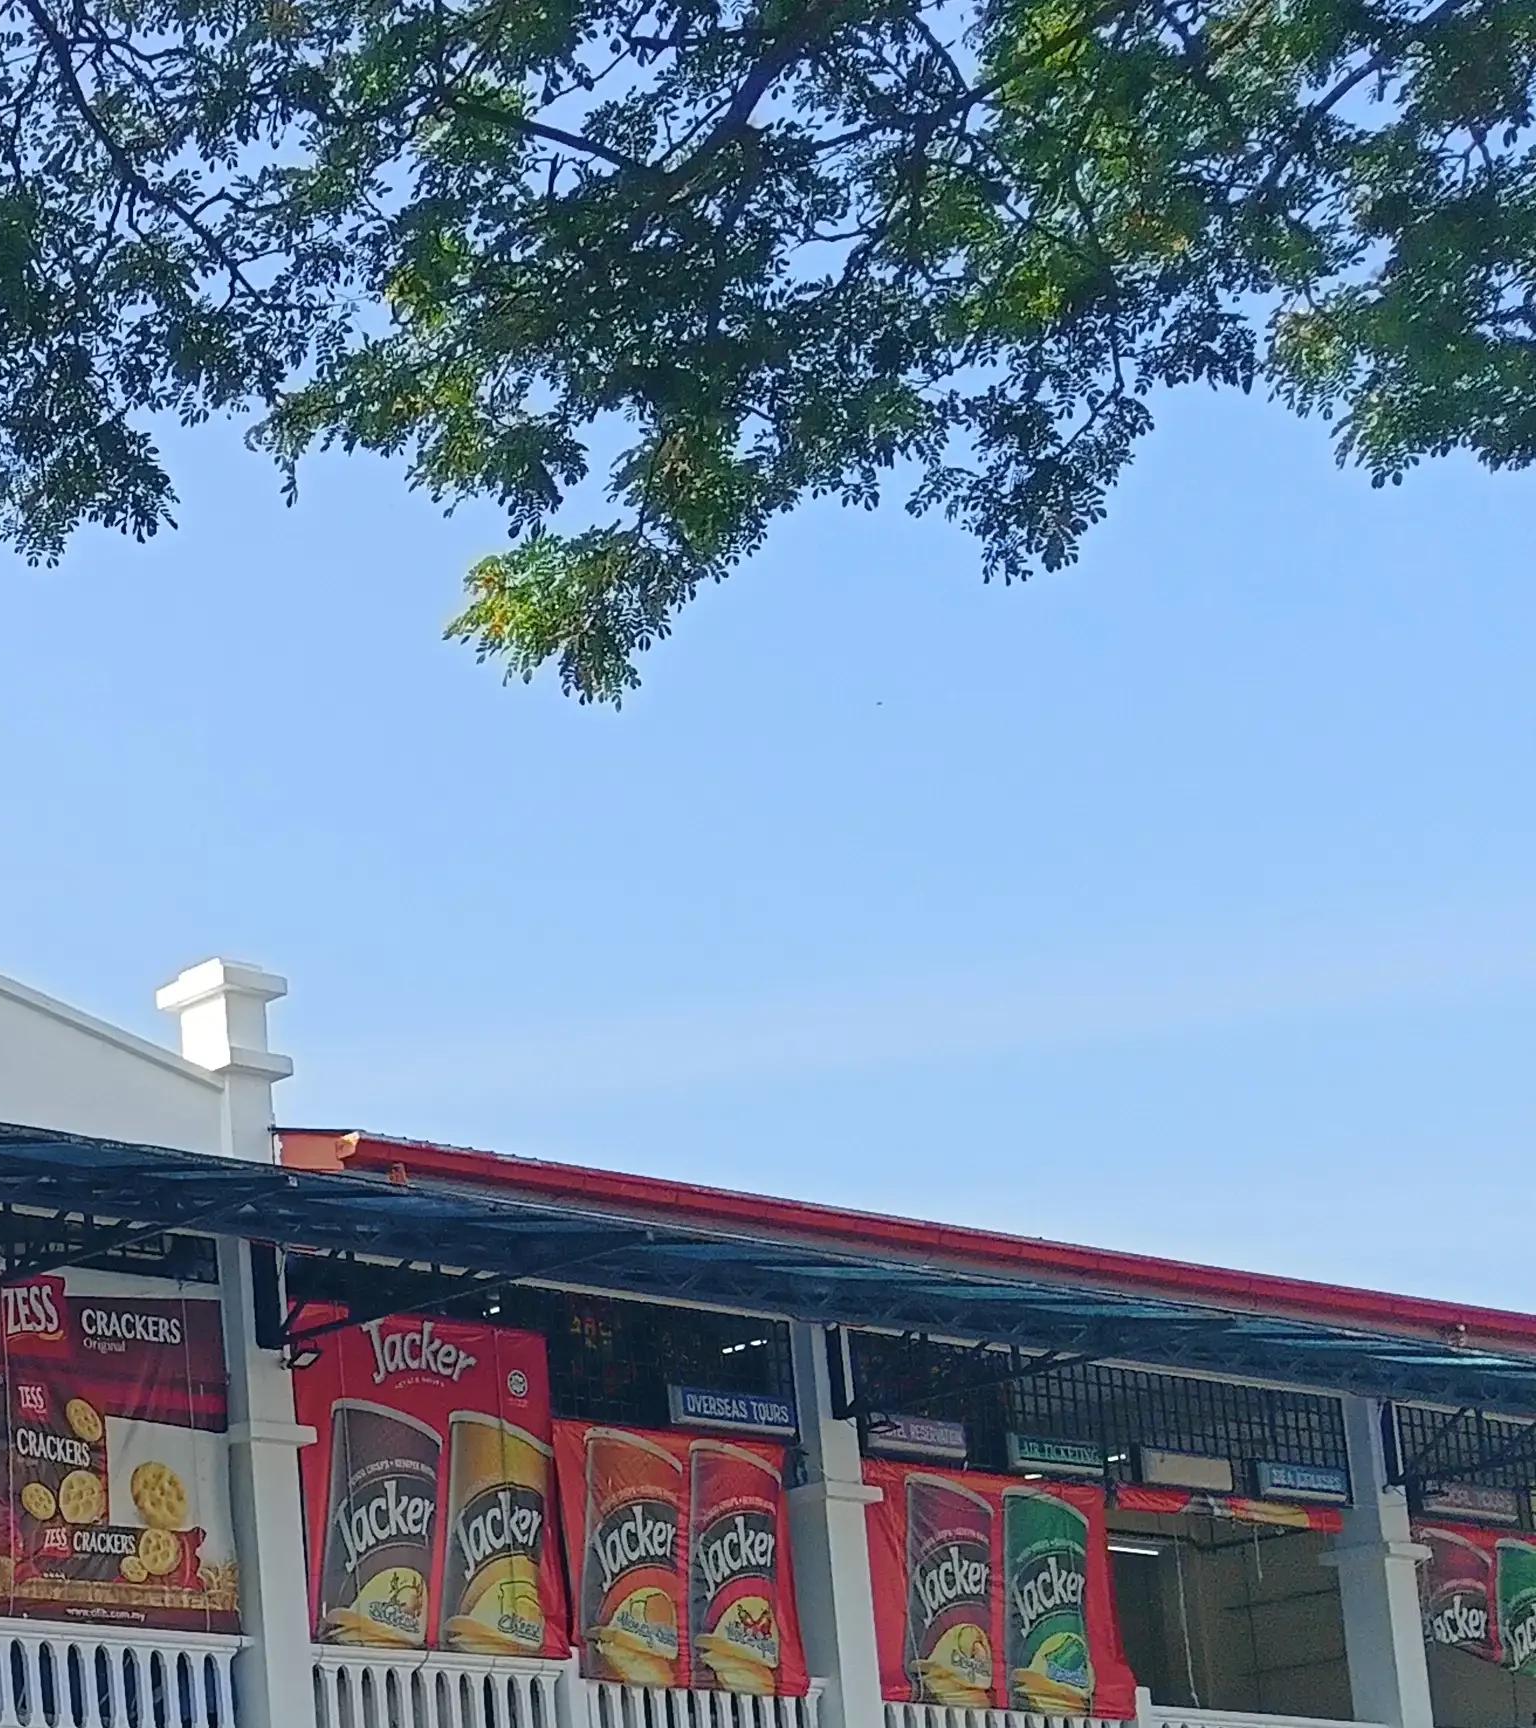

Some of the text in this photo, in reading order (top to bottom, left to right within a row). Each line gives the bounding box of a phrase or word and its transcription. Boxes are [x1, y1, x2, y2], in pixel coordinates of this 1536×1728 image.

[1, 1285, 59, 1335] ZESS
[81, 1308, 182, 1345] CRACKERS
[83, 1336, 126, 1354] Original
[360, 1316, 477, 1384] Jacker
[686, 1393, 789, 1425] OVERSEAS TOURS
[16, 1427, 91, 1468] CRACKERS
[43, 1527, 137, 1555] ZESS CRACKERS
[334, 1480, 435, 1573] Jacker
[455, 1490, 543, 1581] Jacker
[592, 1505, 676, 1592] Jacker
[699, 1515, 775, 1600] Jacker
[914, 1546, 990, 1629] Jacker
[1012, 1556, 1085, 1638] Jacker
[1426, 1595, 1488, 1644] acker
